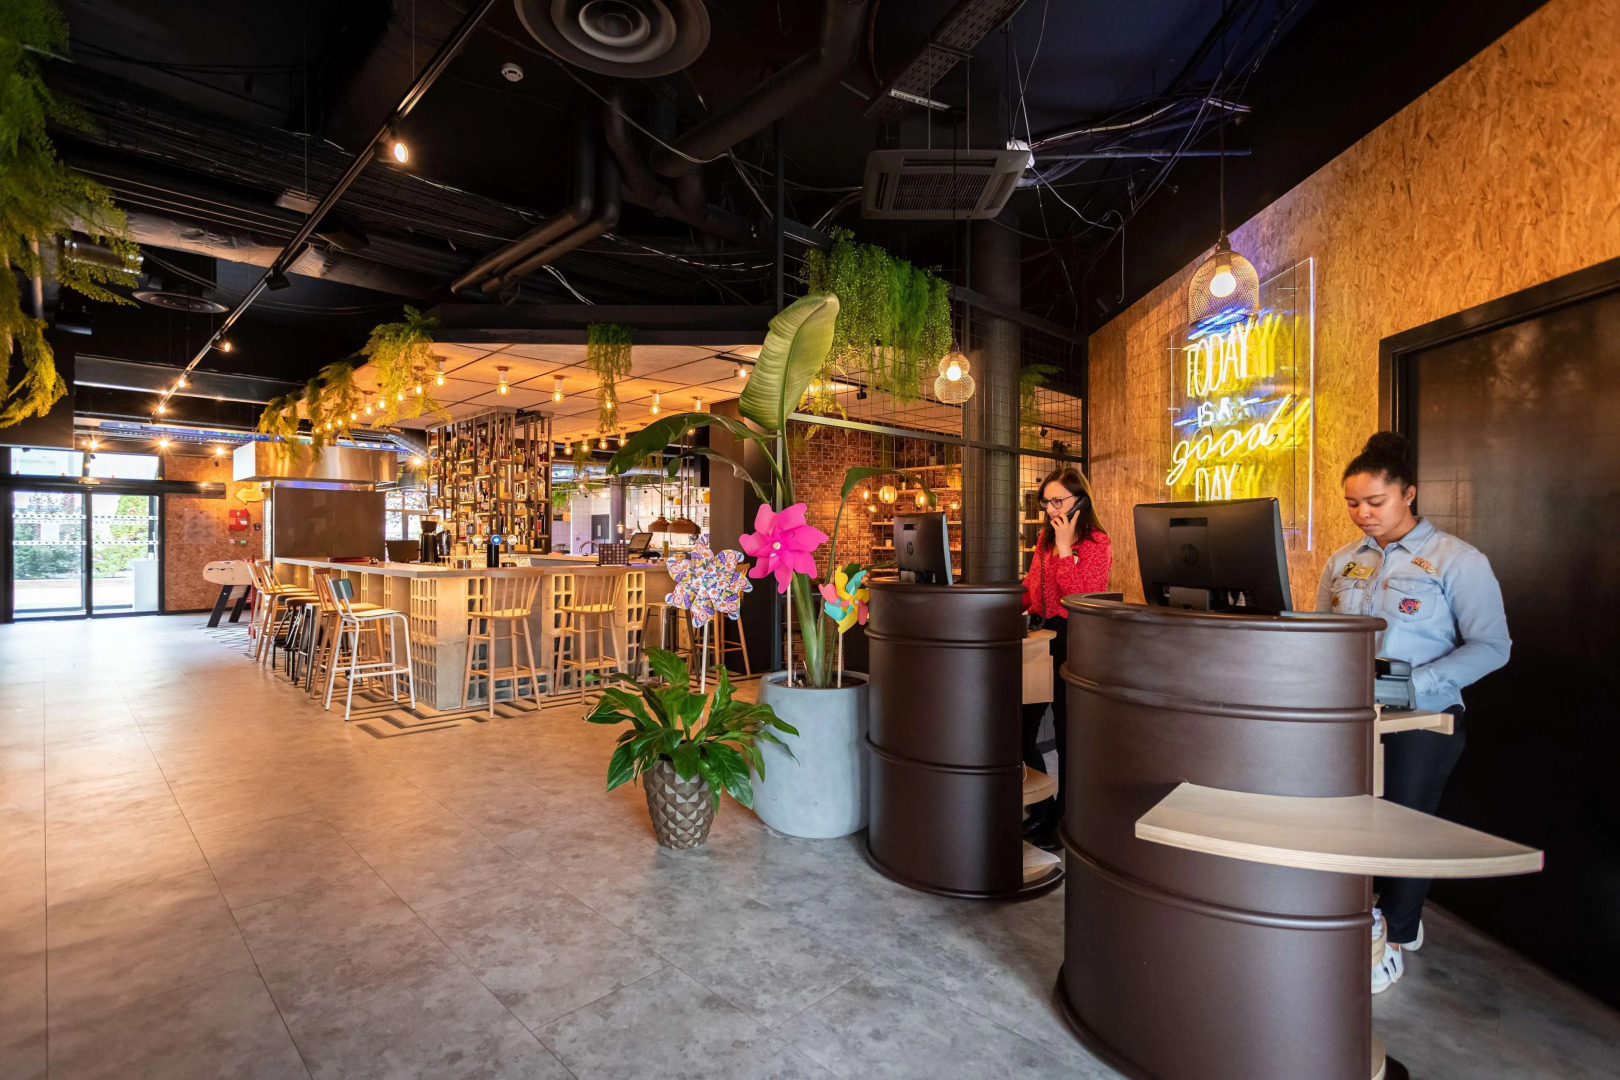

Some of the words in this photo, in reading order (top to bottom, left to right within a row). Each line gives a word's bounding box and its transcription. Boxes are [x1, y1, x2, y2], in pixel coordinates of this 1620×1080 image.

[1182, 313, 1253, 397] TODAY
[1166, 394, 1292, 486] good
[1197, 401, 1215, 428] IS
[1218, 396, 1232, 423] A
[1195, 463, 1238, 502] DAY
